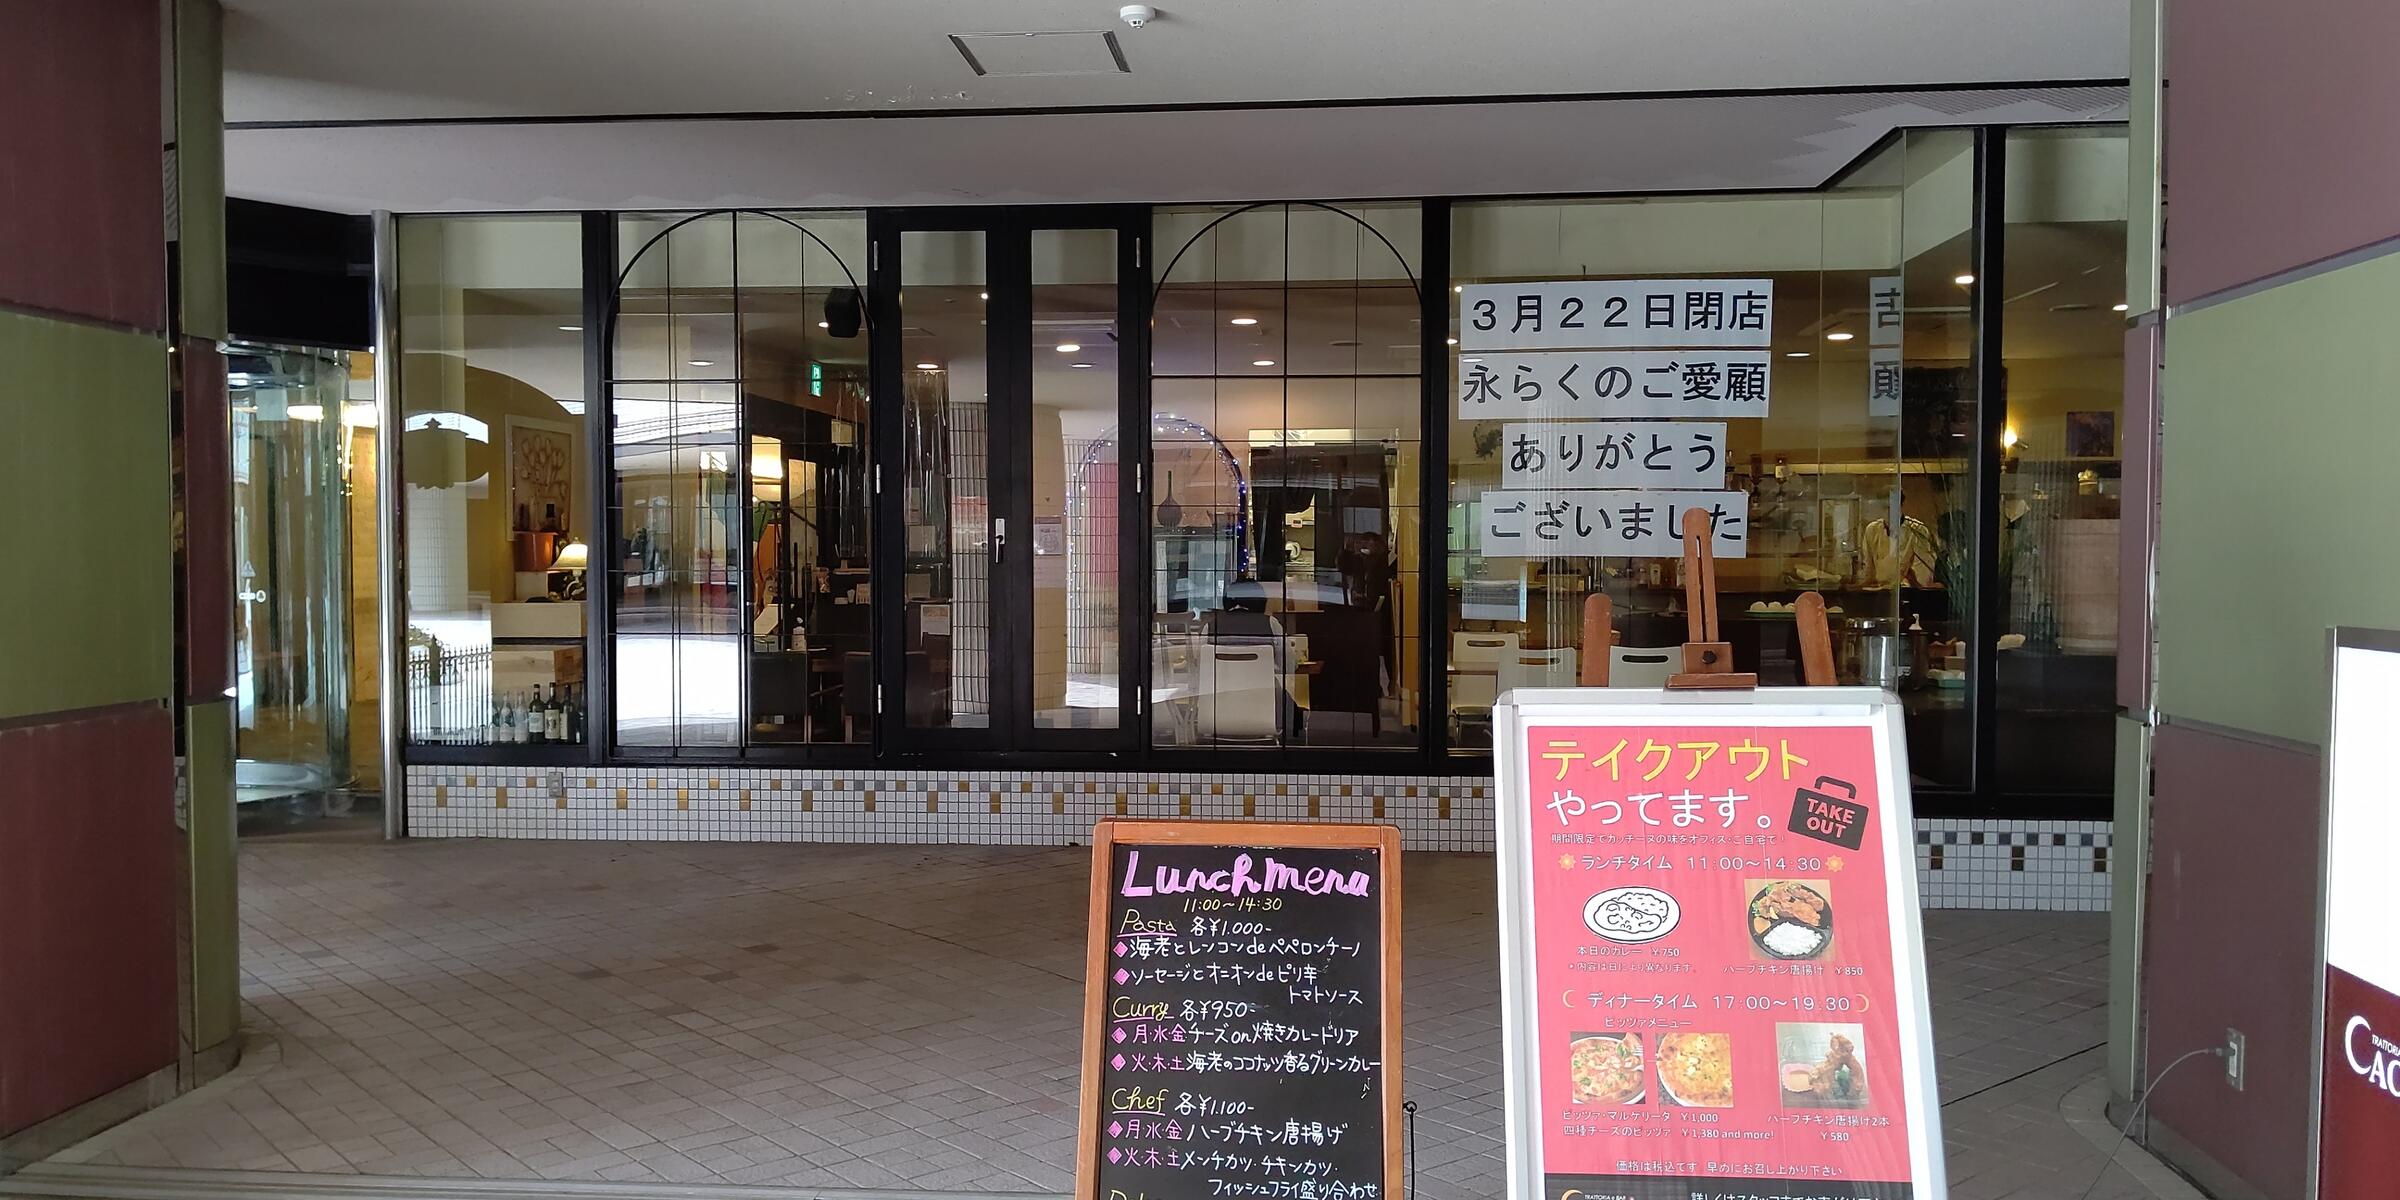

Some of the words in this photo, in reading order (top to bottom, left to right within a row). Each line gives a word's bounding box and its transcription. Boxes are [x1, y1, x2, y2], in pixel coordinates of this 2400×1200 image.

[1472, 290, 1768, 334] 3月22日閉店
[1463, 361, 1767, 404] 永らくのご愛顧
[1510, 432, 1717, 474] ありがとう
[1491, 500, 1743, 542] ございました
[1541, 738, 1809, 782] テイクアウト
[1547, 788, 1771, 828] やってます。
[1807, 798, 1856, 824] TAKE
[1806, 816, 1847, 838] OUT
[1120, 850, 1263, 897] Lunch
[1581, 855, 1673, 870] ランチタイム
[1120, 909, 1177, 933] Pasta
[1130, 936, 1361, 960] 海老とレンコンdeペペロンチーノ
[1577, 945, 1642, 957] 本日のカレー
[1131, 962, 1318, 985] ソーセージとオニオンdeピリ辛
[1289, 985, 1363, 1005] トマトソース
[1587, 991, 1698, 1009] ディナータイム
[1112, 996, 1170, 1021] Curry
[1112, 1087, 1169, 1111] Chef
[1721, 1129, 1740, 1139] and
[1743, 1130, 1774, 1140] more!
